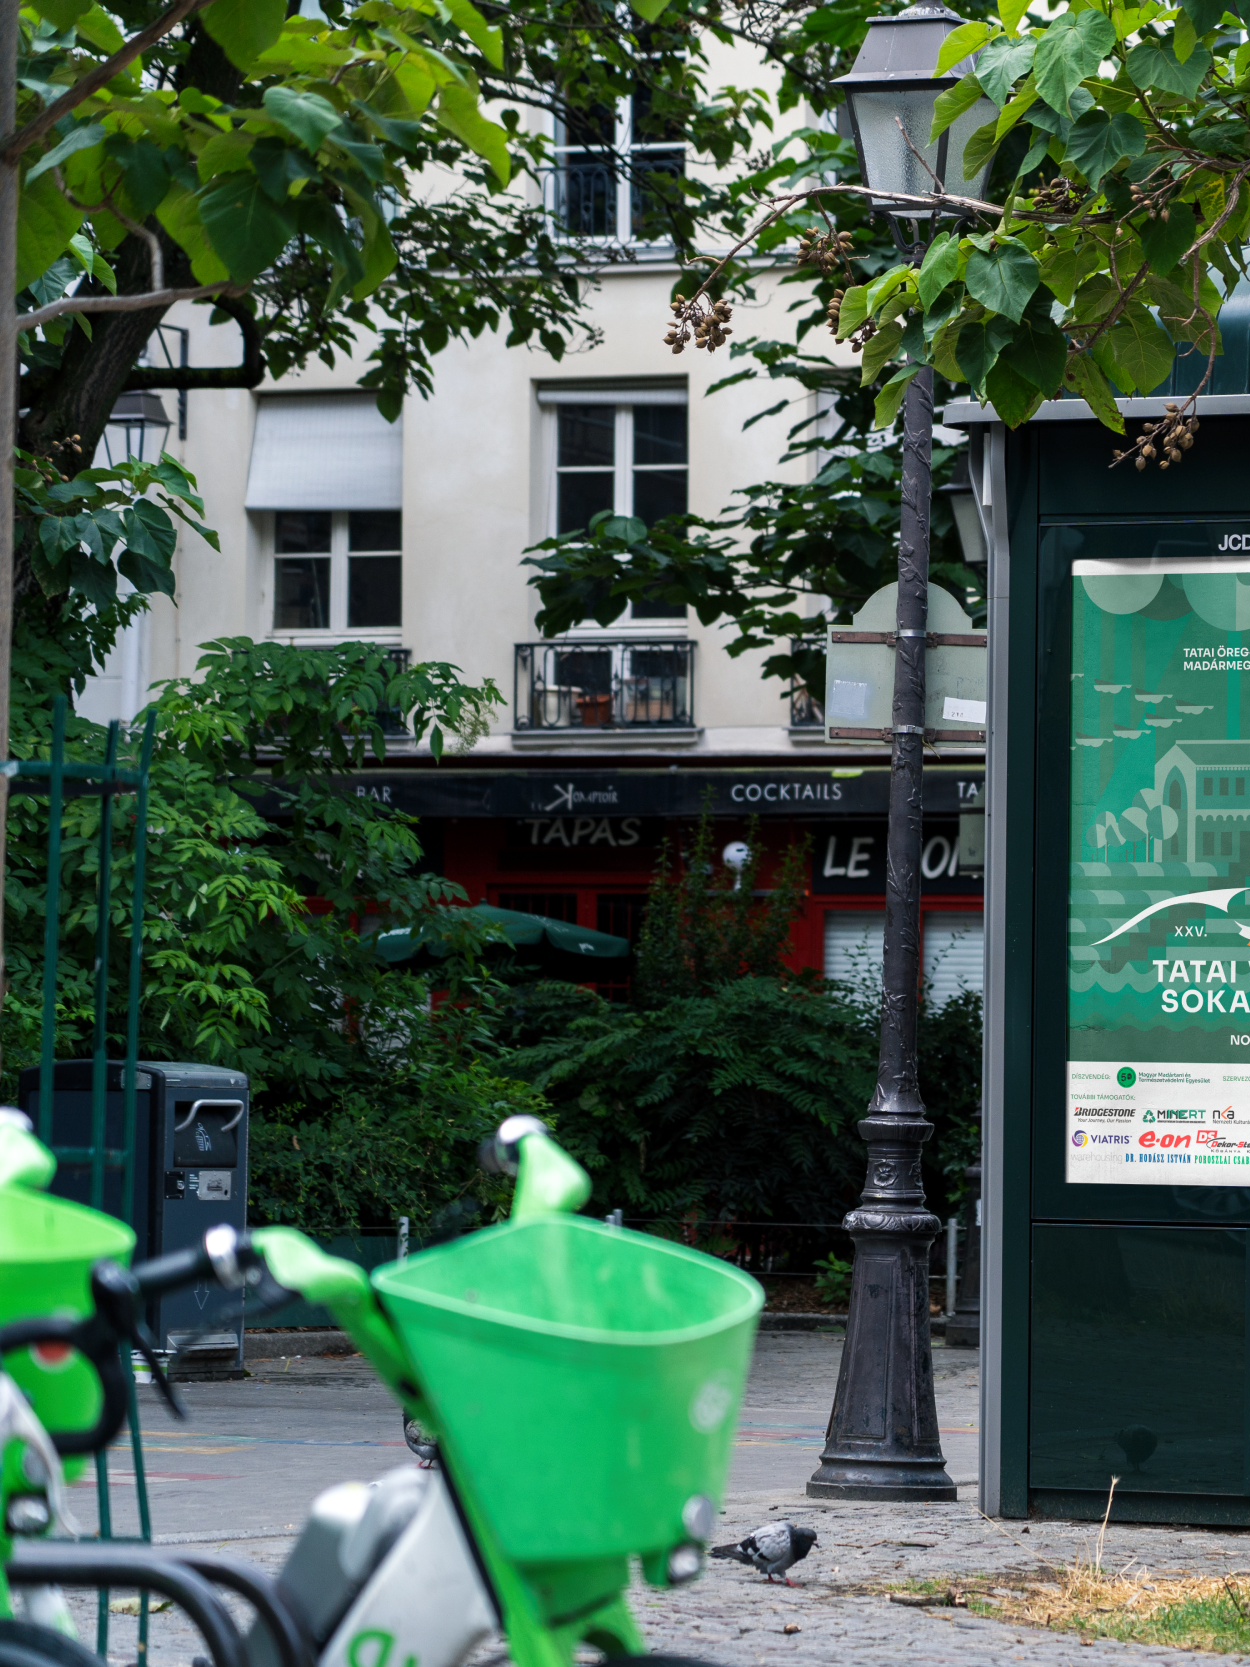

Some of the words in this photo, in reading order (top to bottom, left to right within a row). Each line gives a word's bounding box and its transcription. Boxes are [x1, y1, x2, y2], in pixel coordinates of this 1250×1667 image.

[1184, 648, 1214, 657] TATAI
[356, 786, 392, 802] BAR
[731, 783, 842, 802] COCKTAILS
[524, 817, 642, 846] TAPAS
[823, 836, 875, 878] LE
[1174, 926, 1208, 937] XXV.
[1152, 960, 1236, 983] TATAI
[1074, 1107, 1136, 1117] BRIDGESTONE
[1157, 1110, 1206, 1119] MINERT
[1090, 1134, 1130, 1144] VIATRIS
[1071, 1152, 1123, 1165] warehousing
[1126, 1154, 1136, 1162] DR.
[1139, 1153, 1164, 1163] HODÁSZ
[1167, 1153, 1191, 1163] ISTVÁN
[1195, 1155, 1230, 1164] POROSZLAI
